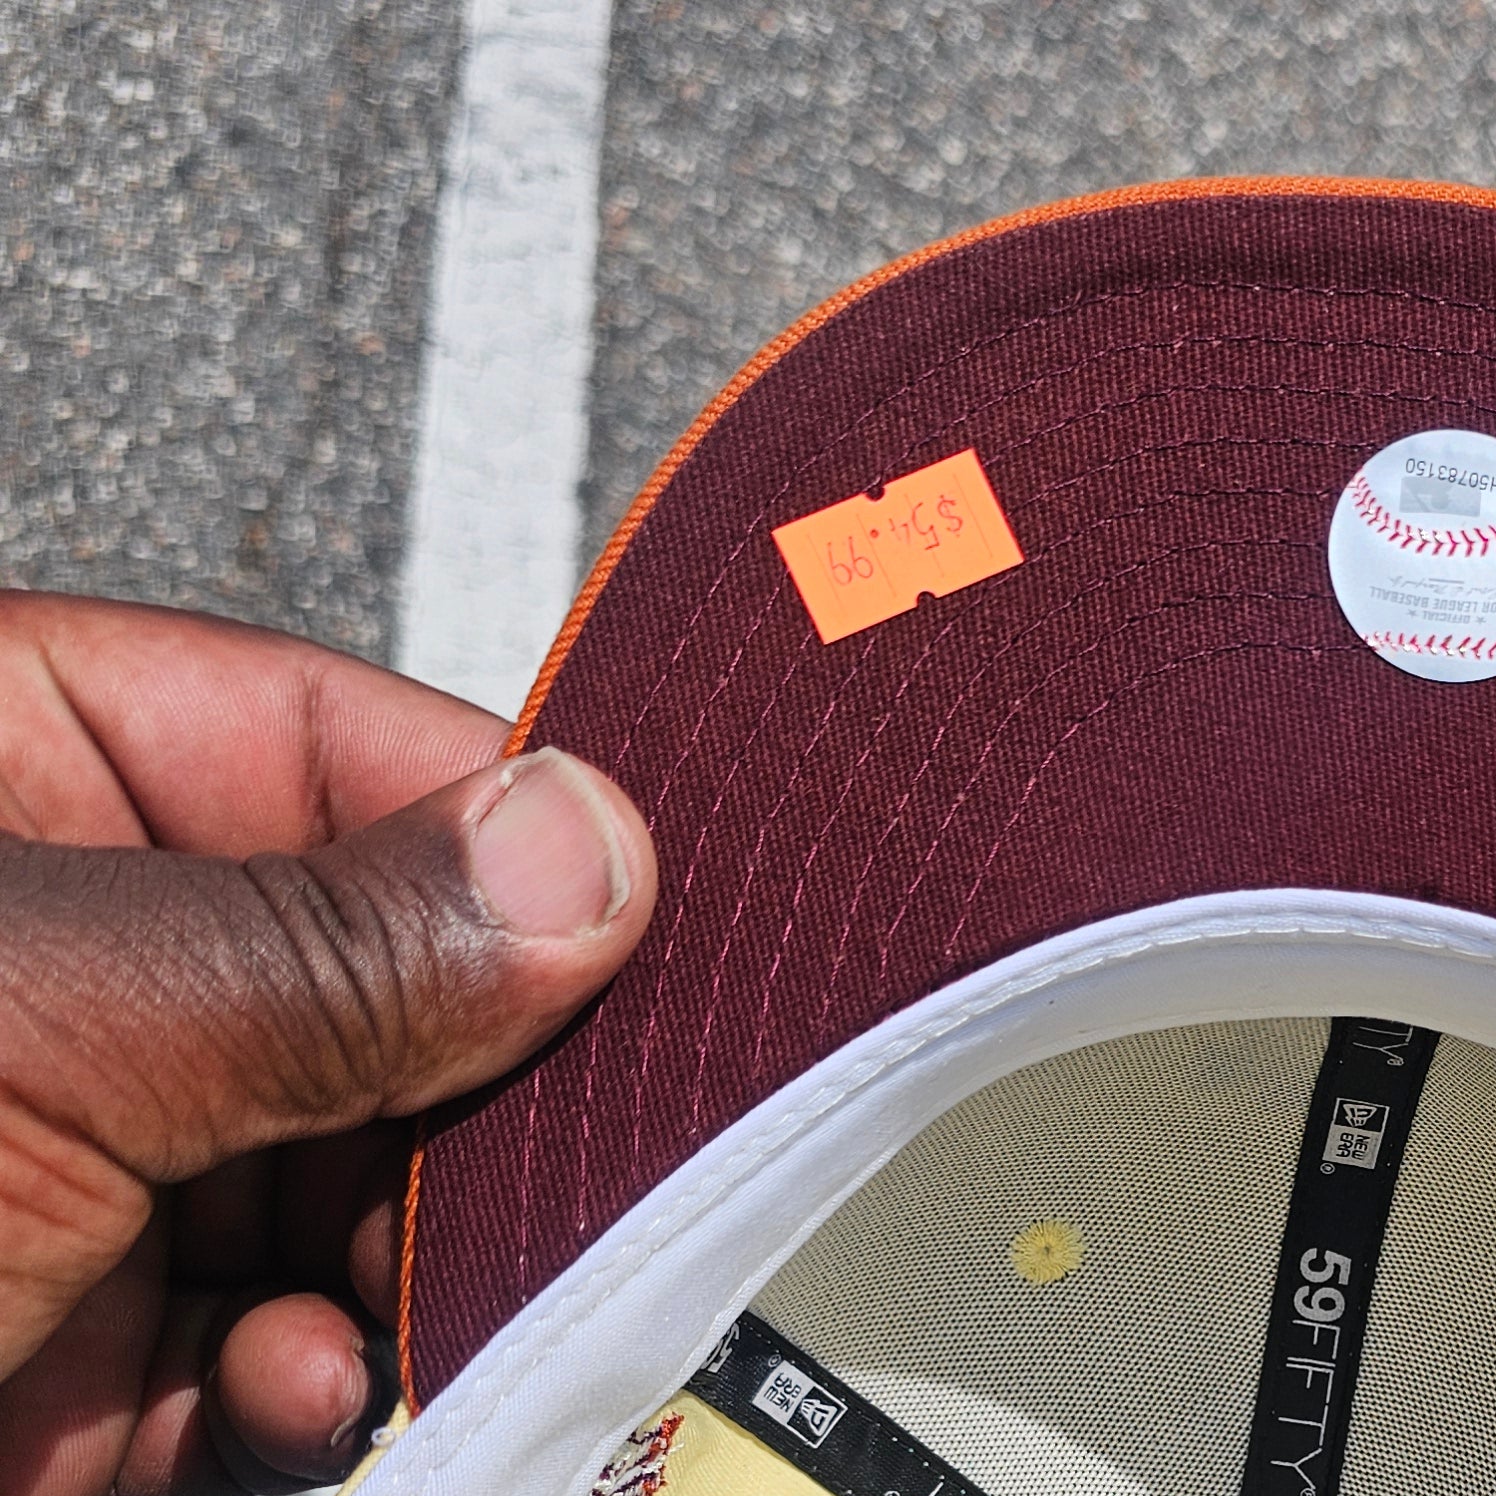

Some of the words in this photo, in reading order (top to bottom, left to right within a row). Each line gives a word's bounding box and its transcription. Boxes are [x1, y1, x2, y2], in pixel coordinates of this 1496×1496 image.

[827, 494, 964, 586] $54.99
[1369, 586, 1429, 608] BASEBALL
[1432, 599, 1479, 613] LEAGUE
[1422, 609, 1472, 625] OFFICIAL
[1335, 1132, 1354, 1159] ERA
[1351, 1134, 1371, 1161] NEW
[763, 1385, 795, 1414] NEW
[773, 1372, 803, 1400] ERA
